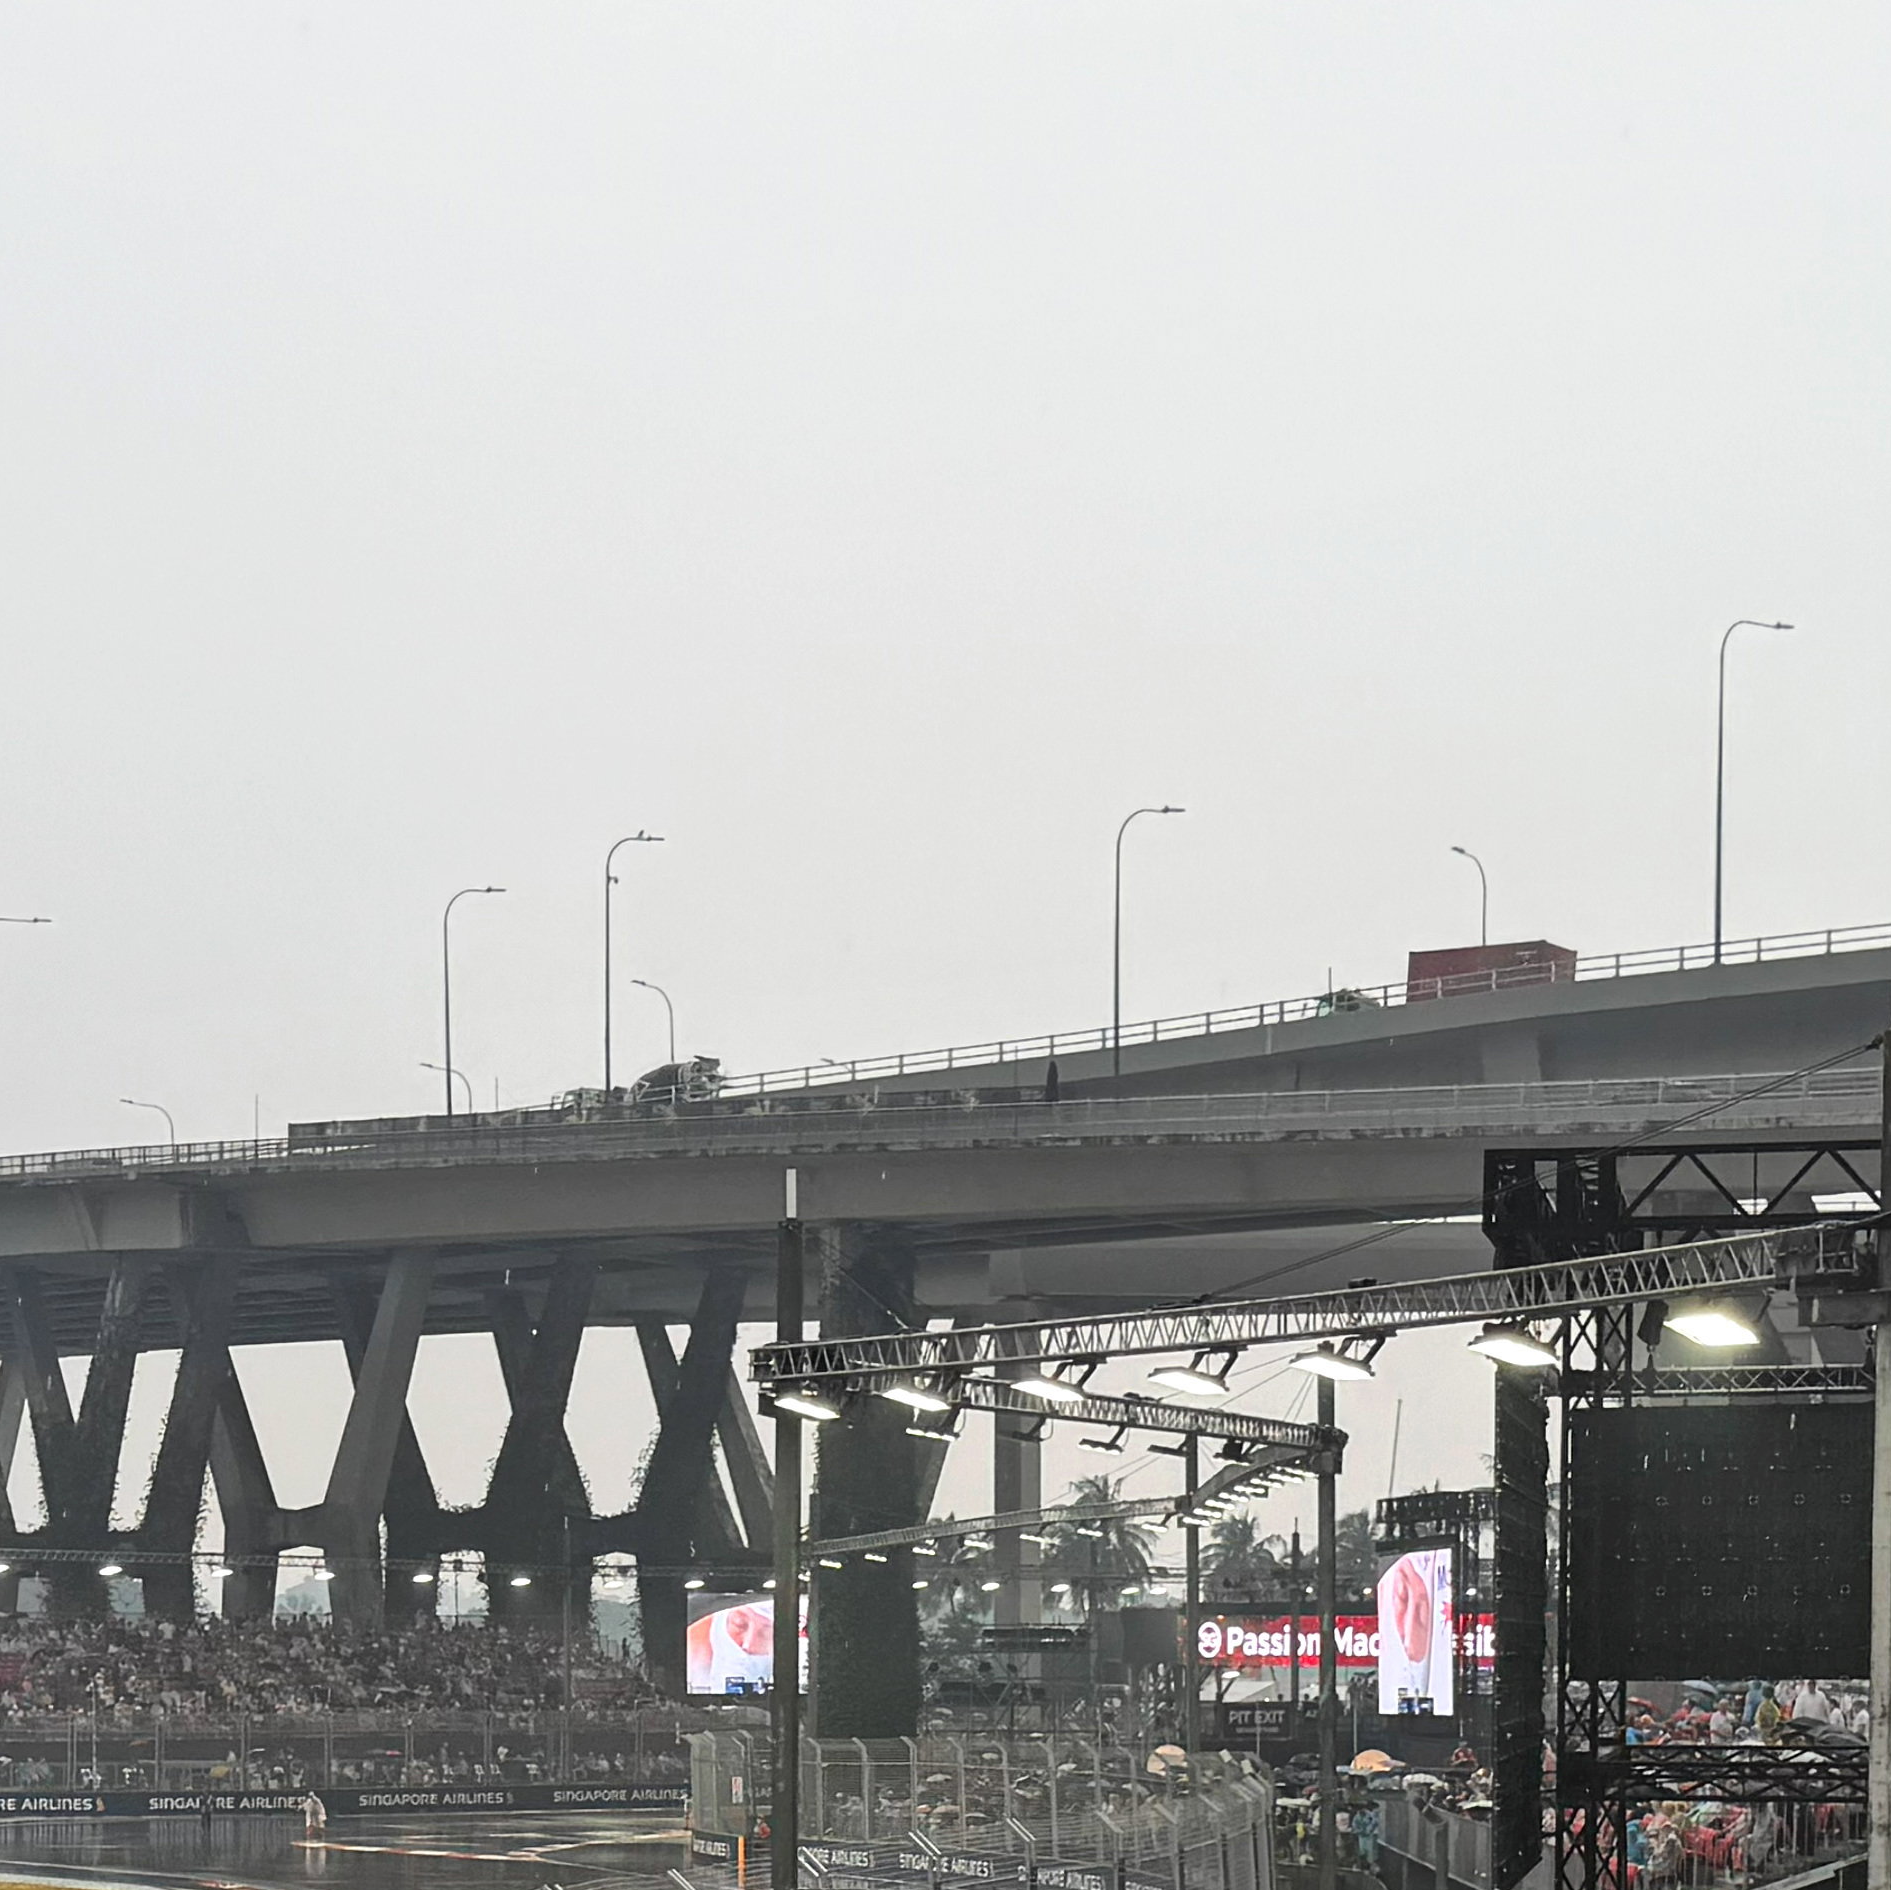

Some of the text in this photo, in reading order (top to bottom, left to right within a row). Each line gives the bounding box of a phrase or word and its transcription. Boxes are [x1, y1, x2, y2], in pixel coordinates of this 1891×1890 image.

[1334, 1626, 1380, 1657] Mad
[1229, 1710, 1286, 1724] PIT EXIT
[21, 1797, 94, 1811] AIRLINES
[359, 1791, 504, 1807] SINGAPORE AIRLINES
